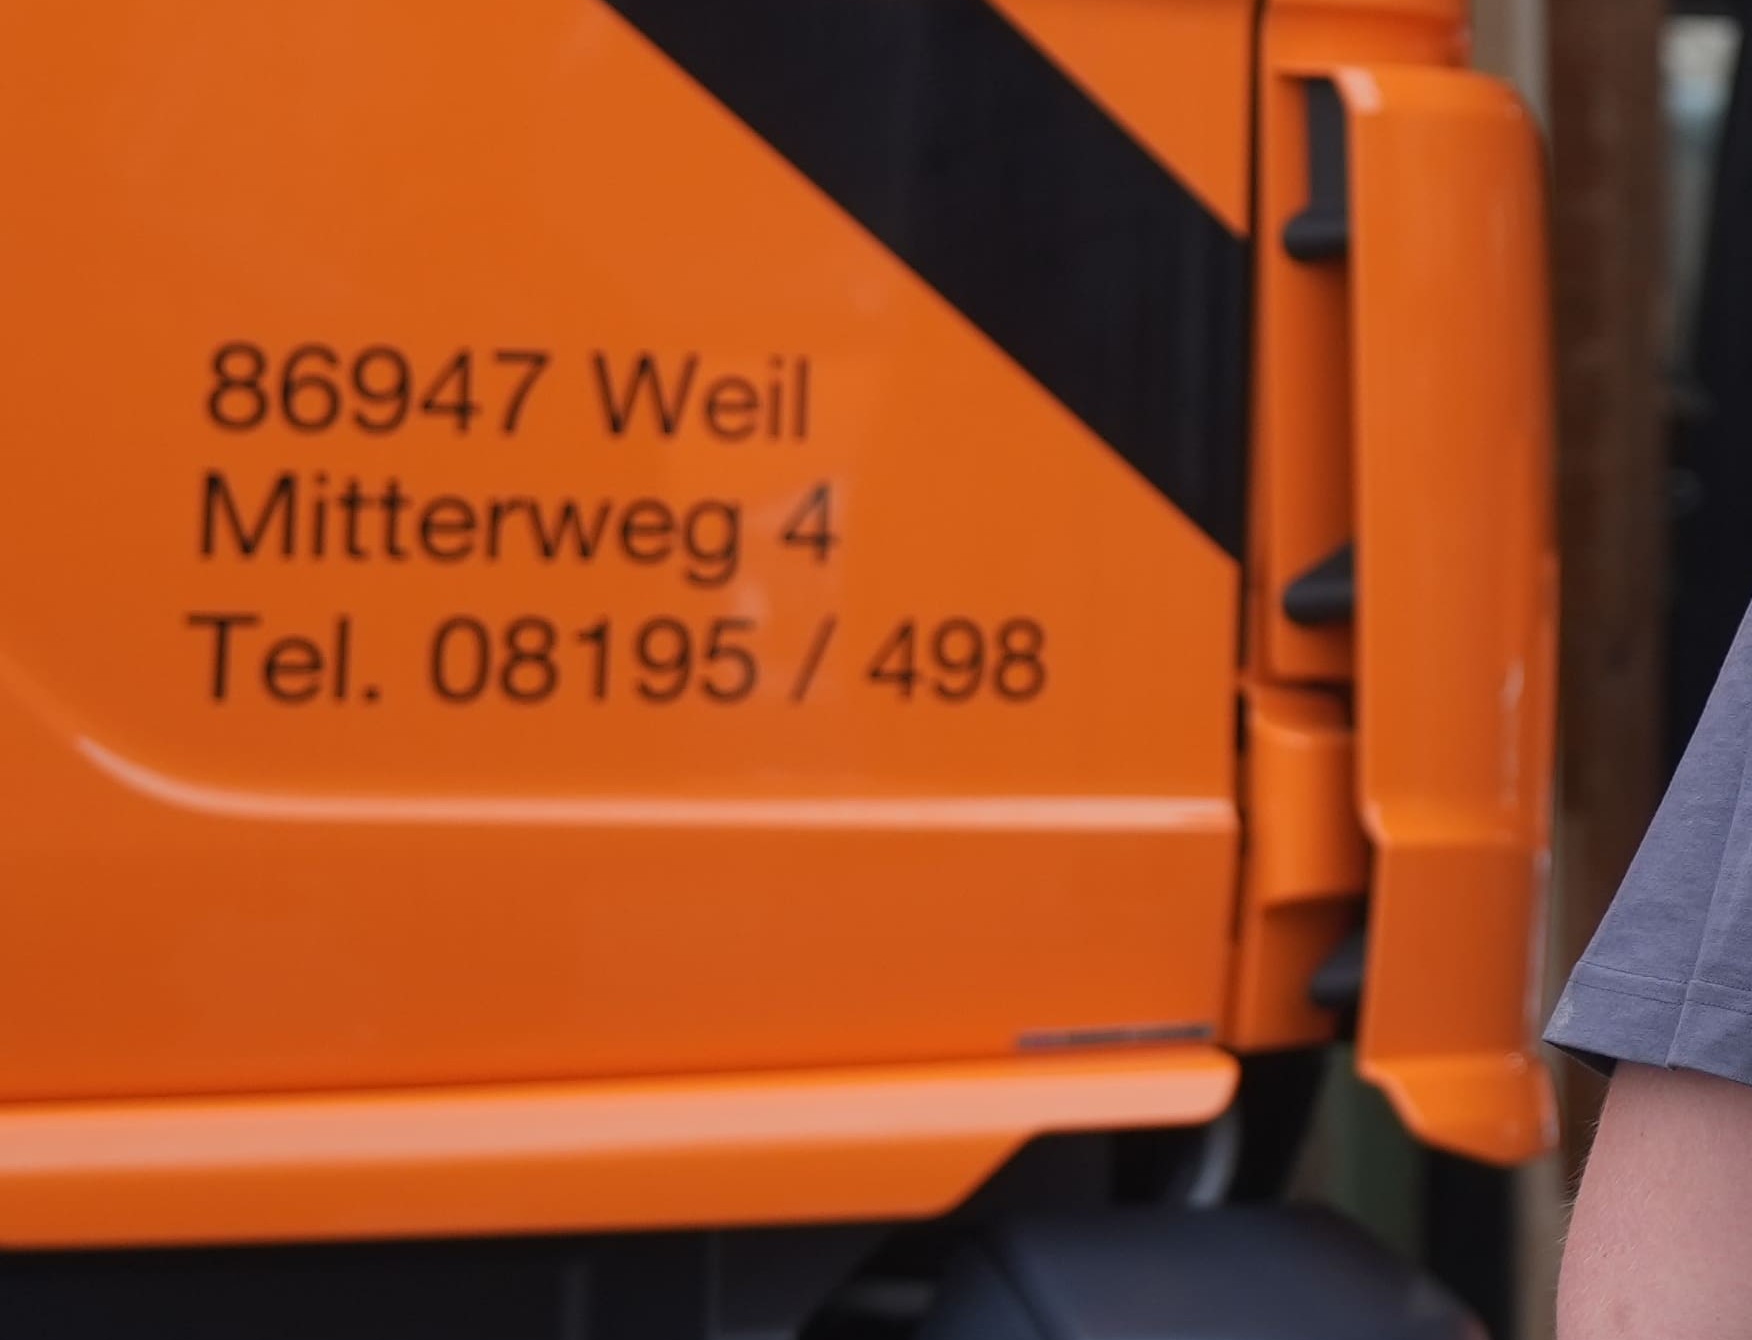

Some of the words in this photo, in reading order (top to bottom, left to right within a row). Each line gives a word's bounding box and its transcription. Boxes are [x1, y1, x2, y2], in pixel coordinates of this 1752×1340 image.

[205, 340, 551, 438] 86947
[590, 348, 813, 443] Weil
[197, 469, 745, 589] Mitterweg
[776, 481, 840, 567] 4
[184, 610, 382, 706] Tel.
[428, 611, 760, 706] 08195
[865, 615, 1049, 705] 498
